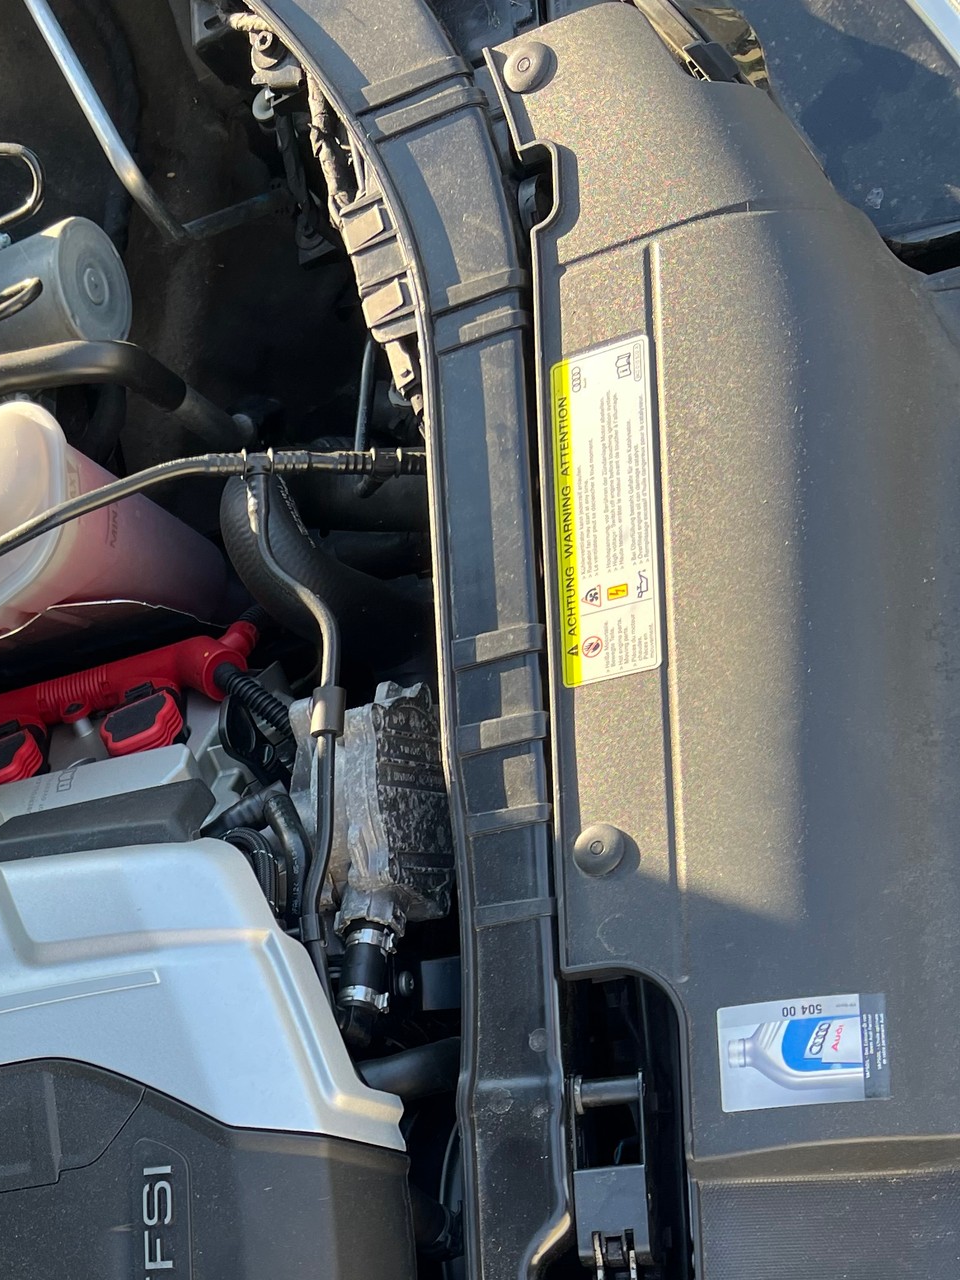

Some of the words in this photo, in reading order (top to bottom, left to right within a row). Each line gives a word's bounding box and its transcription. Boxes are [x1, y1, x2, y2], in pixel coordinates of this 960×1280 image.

[558, 396, 570, 476] ATTENTION
[561, 486, 573, 560] WARNING
[565, 566, 576, 636] ACHTUNG
[782, 1006, 796, 1017] 00
[801, 1004, 822, 1015] 504
[831, 1024, 844, 1052] Audi
